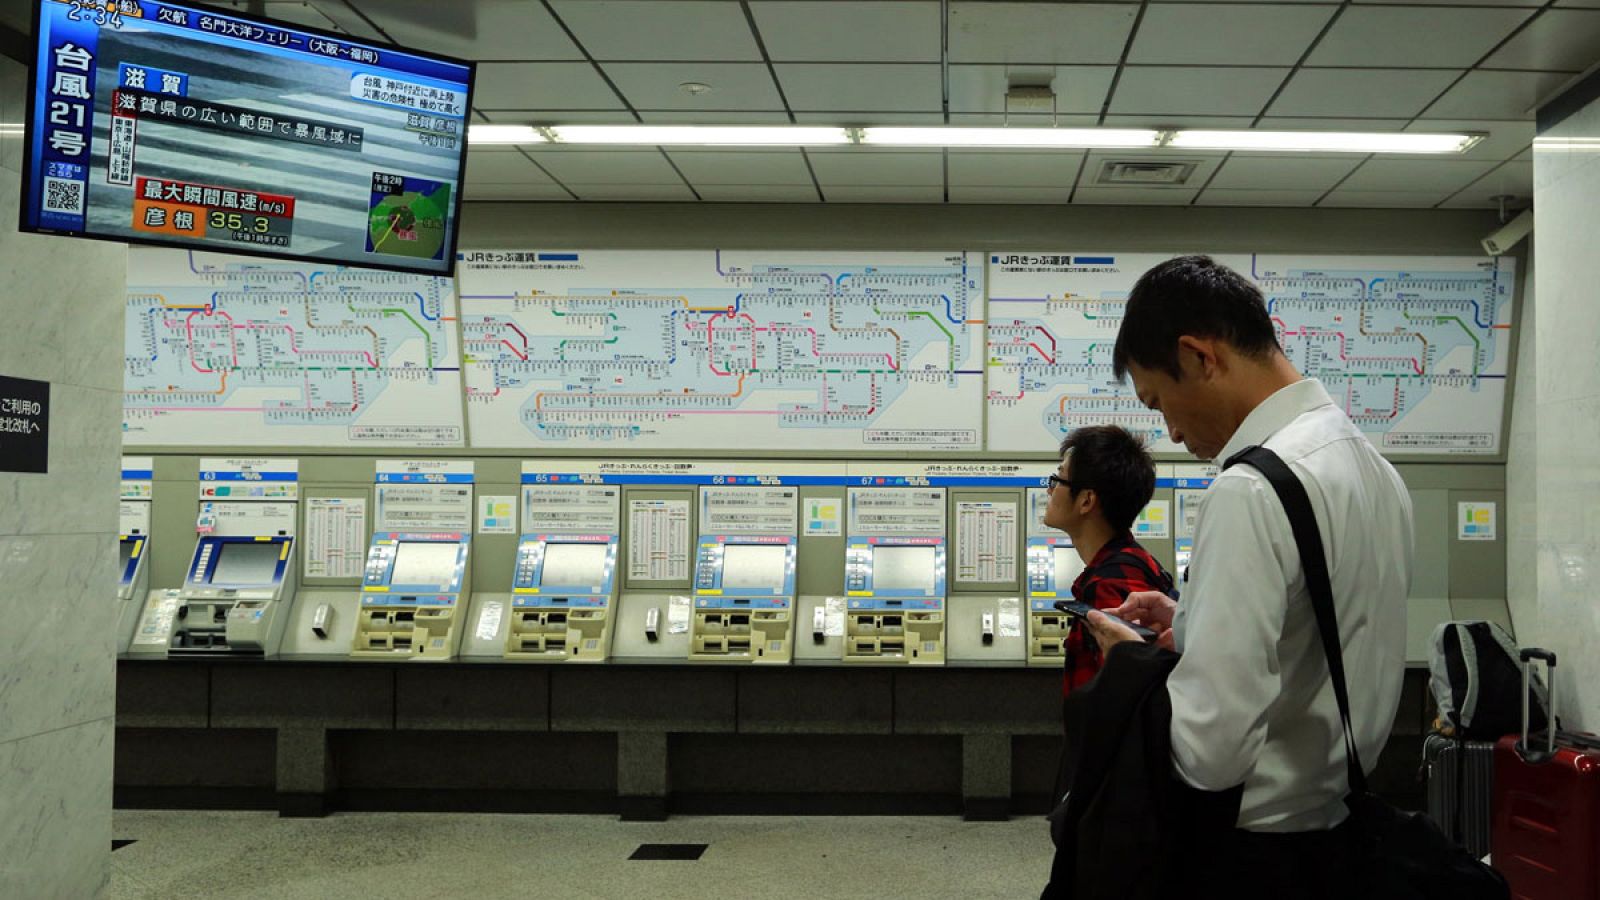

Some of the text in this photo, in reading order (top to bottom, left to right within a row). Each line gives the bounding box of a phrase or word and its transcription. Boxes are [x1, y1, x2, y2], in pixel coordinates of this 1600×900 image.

[69, 1, 122, 28] 2:34
[159, 8, 188, 25] 欠航
[125, 67, 181, 95] 滋賀
[363, 76, 381, 89] 台風
[49, 43, 93, 157] 台風21号
[363, 87, 415, 107] 災害の危険性
[119, 92, 361, 146] 滋賀県の広い範囲で暴風域に
[144, 208, 269, 233] 彦根 35.3
[466, 252, 535, 263] JRきっぷ運賃
[1001, 255, 1070, 266] JRきっぷ運賃
[1, 398, 40, 415] ご利用の
[862, 475, 873, 485] 67
